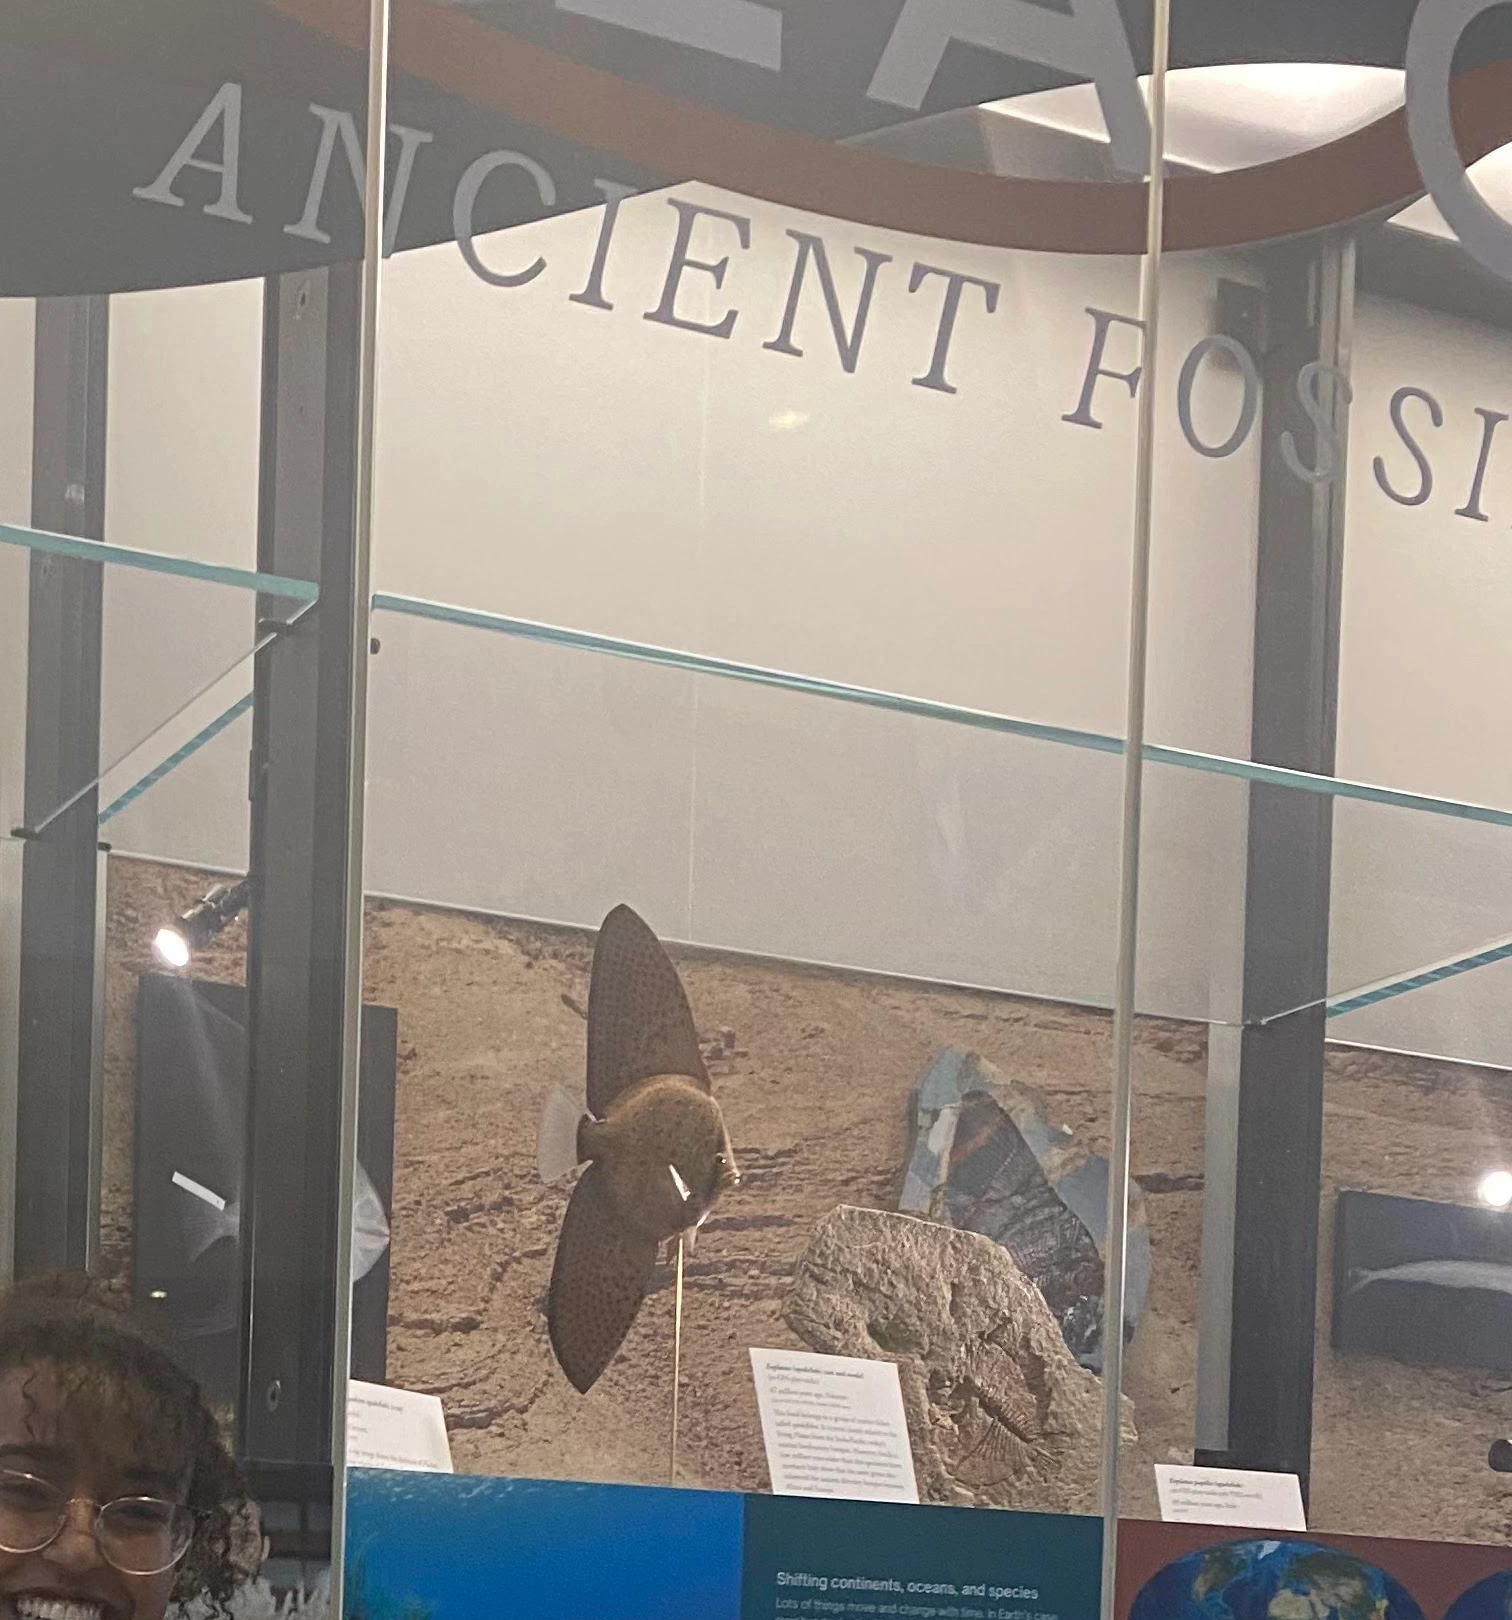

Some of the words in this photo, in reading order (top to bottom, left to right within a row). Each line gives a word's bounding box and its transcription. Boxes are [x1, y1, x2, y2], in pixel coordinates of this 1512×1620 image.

[132, 81, 1001, 396] ANCIENT
[1061, 307, 1512, 522] FOSSI
[777, 1572, 827, 1590] Shifting
[831, 1576, 904, 1593] continents,
[908, 1581, 958, 1596] oceans,
[962, 1582, 985, 1596] and
[989, 1585, 1038, 1600] species
